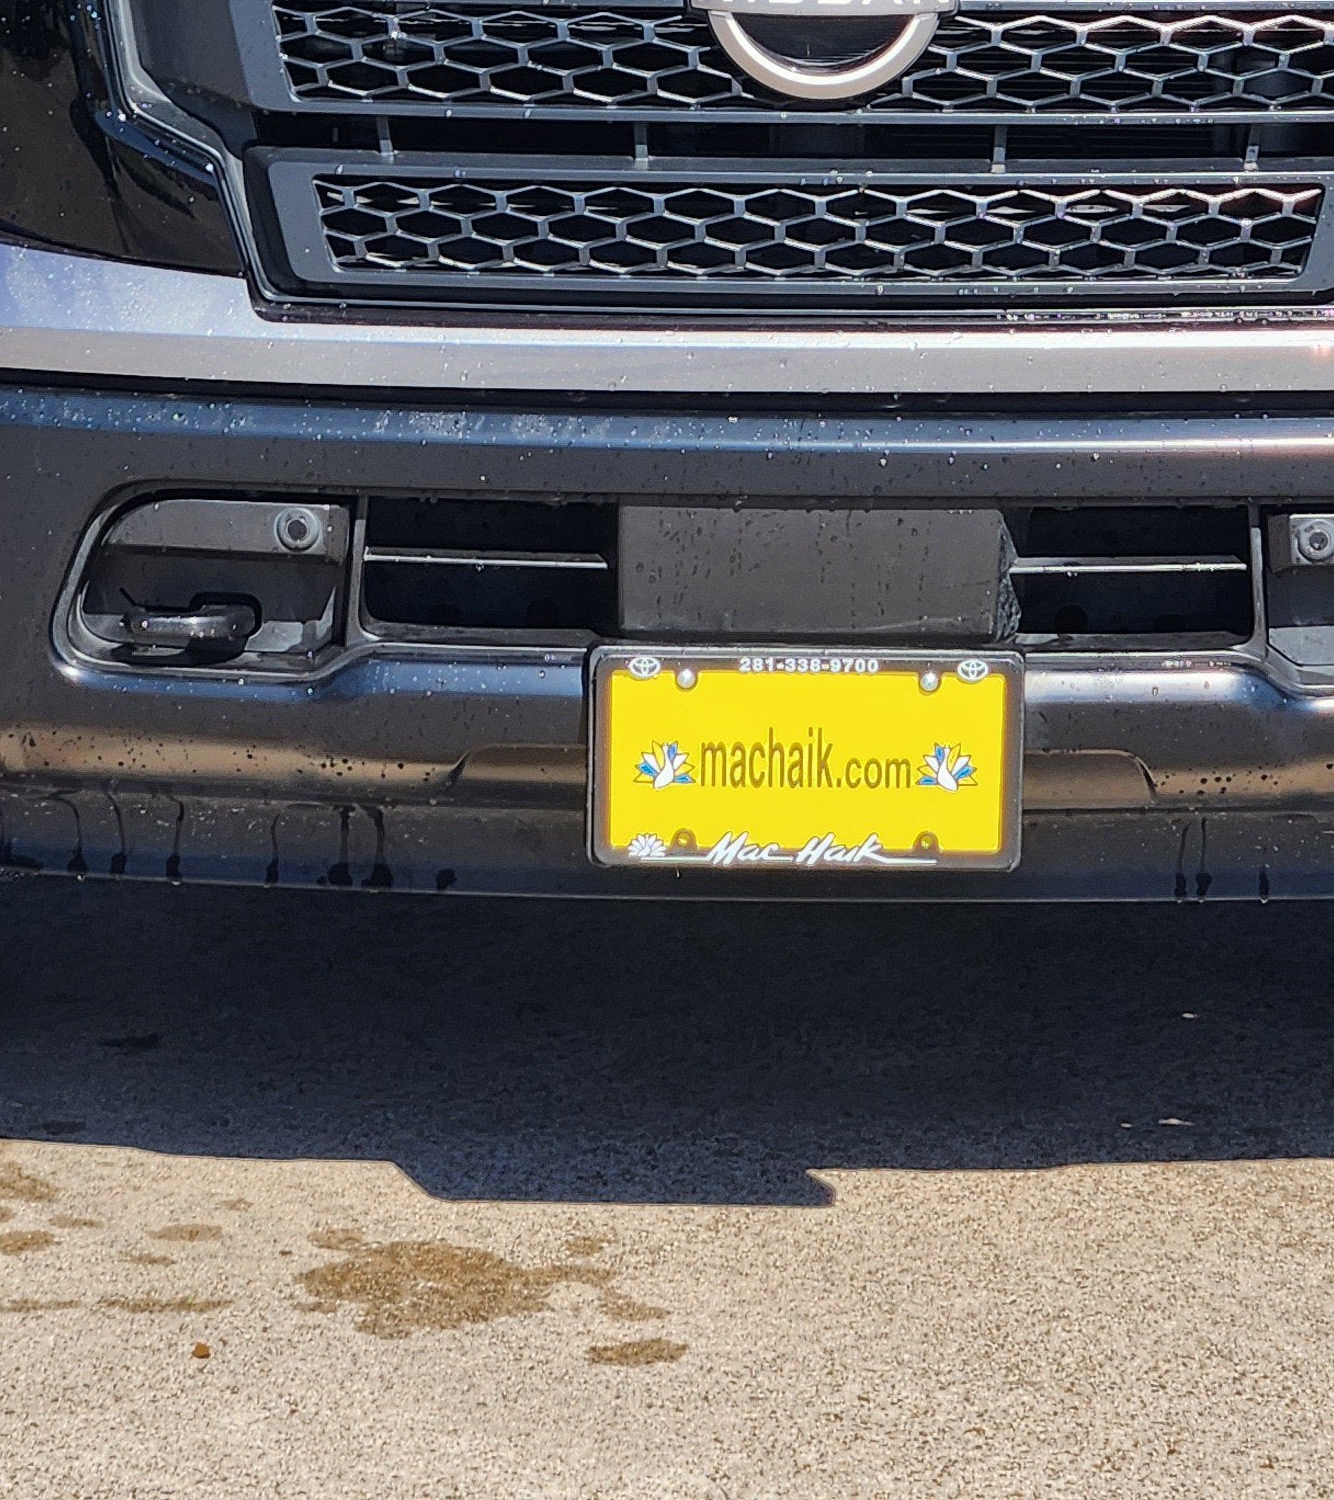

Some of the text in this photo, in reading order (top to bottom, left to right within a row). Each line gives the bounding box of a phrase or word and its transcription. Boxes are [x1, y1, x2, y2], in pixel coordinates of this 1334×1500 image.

[700, 727, 911, 790] machaik.com
[705, 831, 884, 866] Mac Haik
